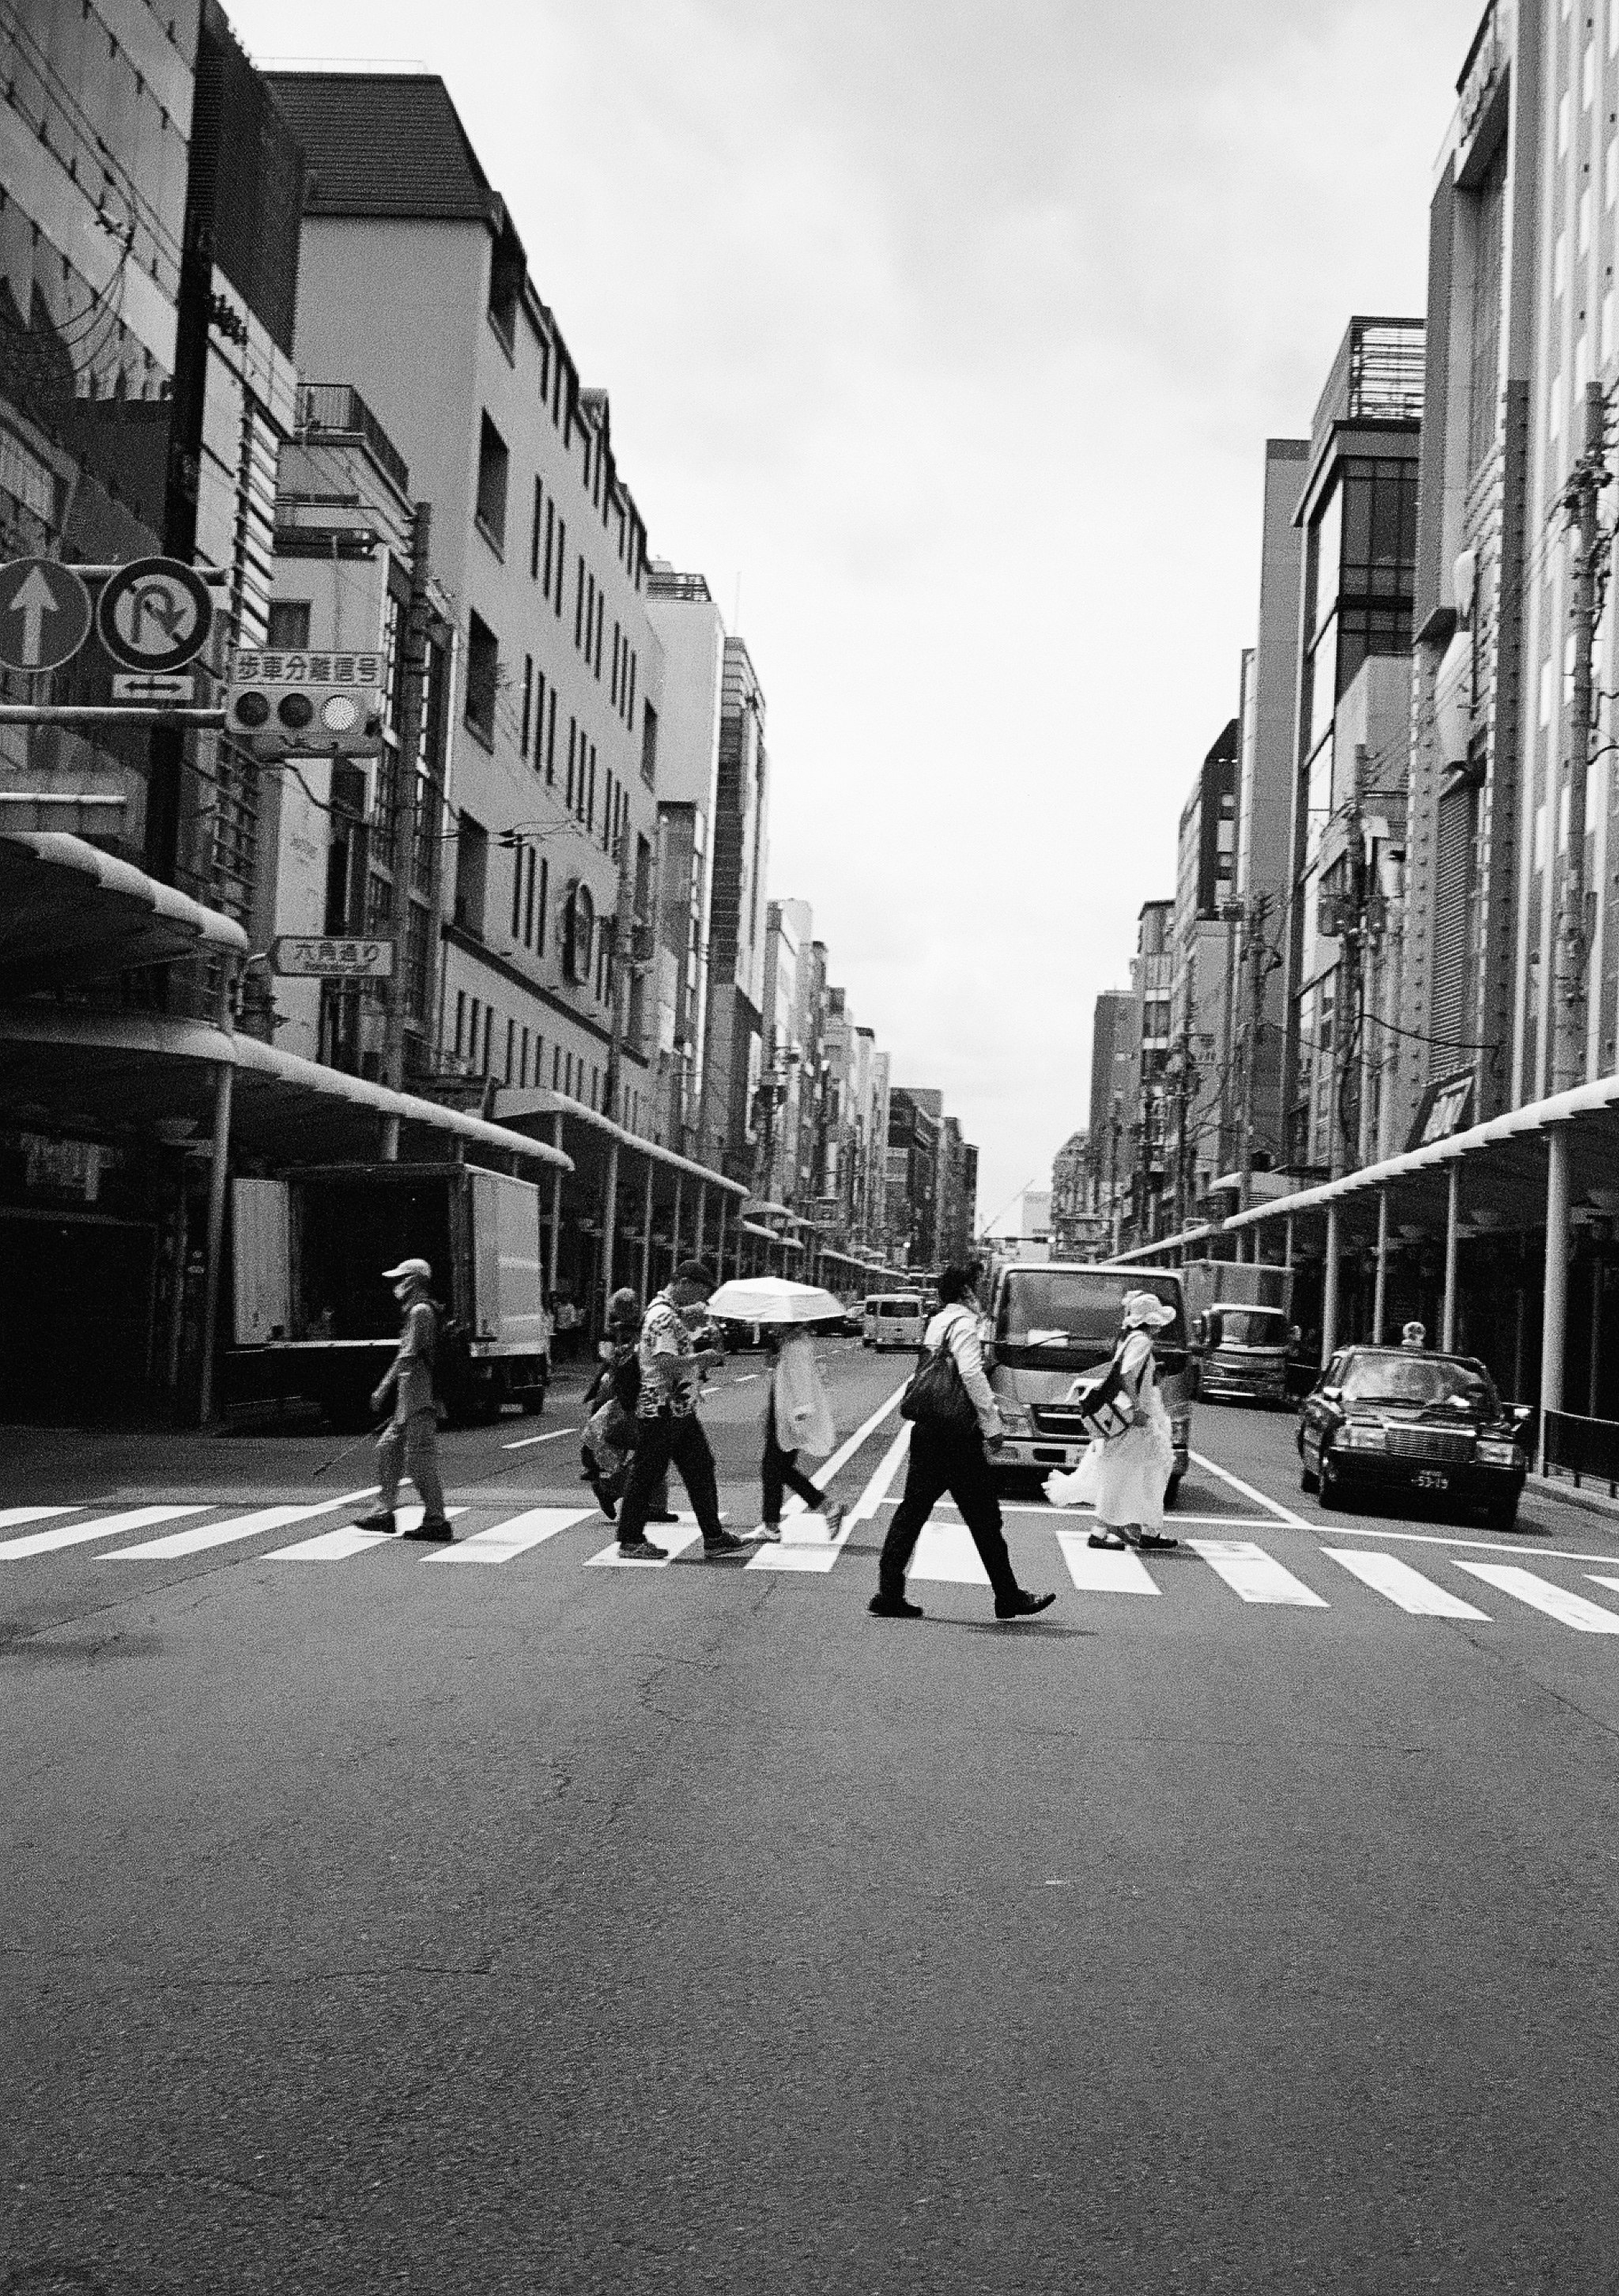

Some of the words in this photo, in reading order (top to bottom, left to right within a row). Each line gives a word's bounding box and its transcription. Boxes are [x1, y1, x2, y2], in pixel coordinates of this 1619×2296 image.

[238, 655, 378, 682] 歩車分離信号
[293, 942, 379, 962] 六角通り
